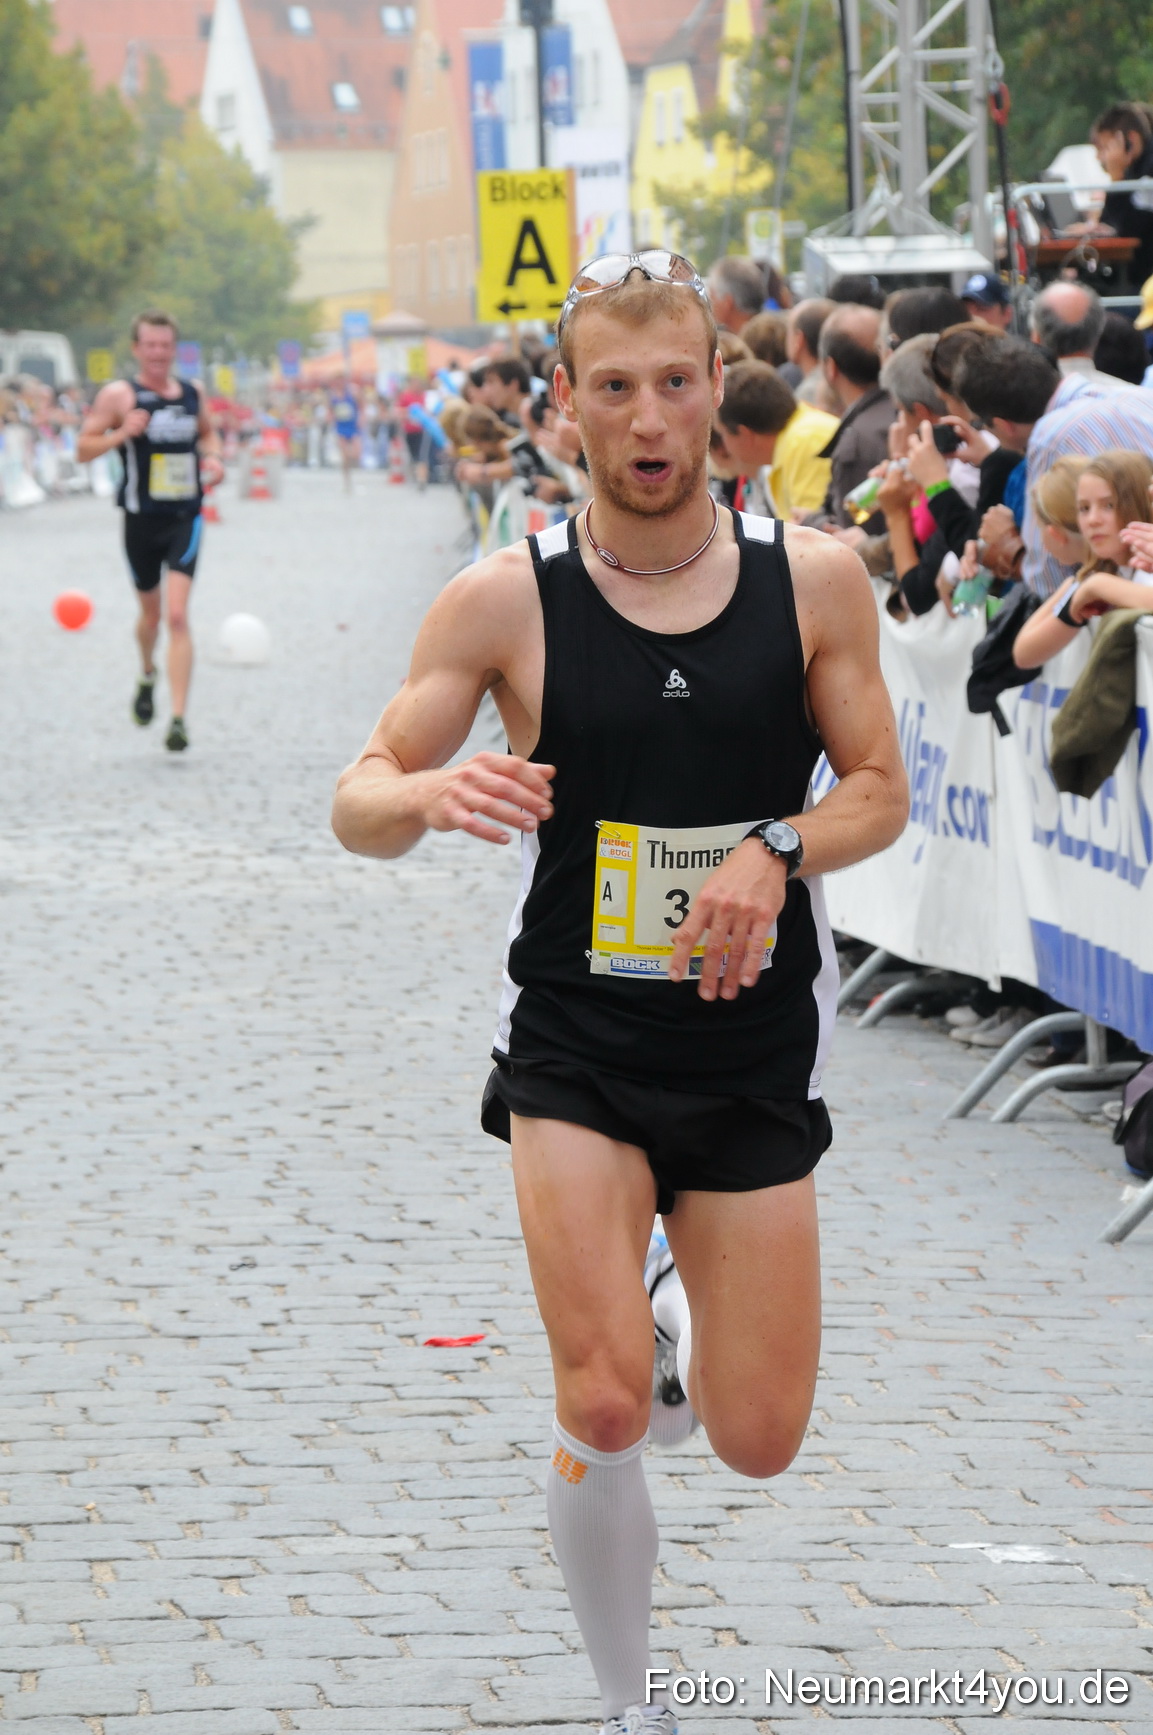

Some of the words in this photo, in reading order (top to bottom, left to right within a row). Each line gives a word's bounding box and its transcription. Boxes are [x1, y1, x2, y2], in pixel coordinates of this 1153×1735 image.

[490, 175, 567, 202] Block
[506, 219, 557, 287] A
[602, 880, 613, 902] A
[610, 957, 661, 971] BOCK
